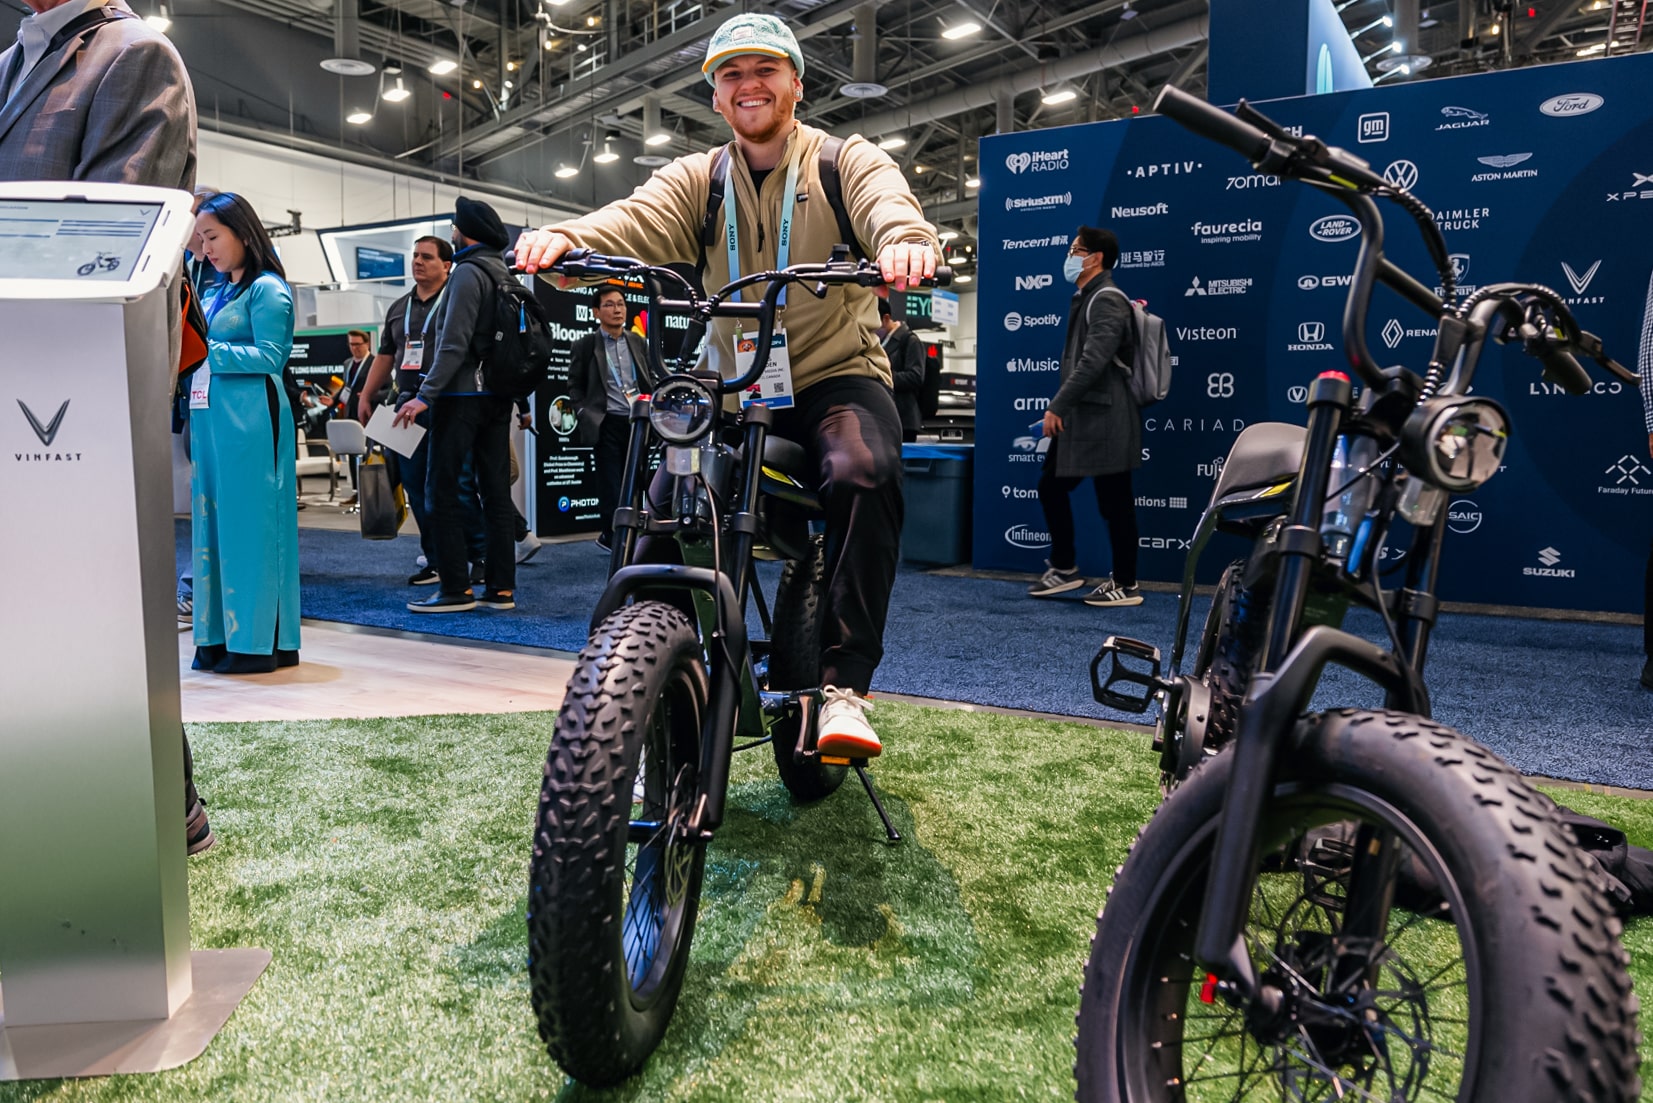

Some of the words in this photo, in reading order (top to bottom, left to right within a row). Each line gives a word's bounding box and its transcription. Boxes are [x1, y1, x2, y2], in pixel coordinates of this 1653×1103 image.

[1553, 97, 1590, 112] Ford
[1363, 119, 1384, 136] gm
[1435, 119, 1490, 131] JAGUAR
[1032, 149, 1069, 162] iHeart
[1031, 159, 1069, 172] RADIO
[1471, 173, 1501, 182] ASTON
[1503, 170, 1538, 180] MARTIN
[1606, 190, 1653, 202] XPE
[1111, 203, 1169, 218] Neusoft
[1193, 219, 1262, 236] faurecia
[1436, 219, 1480, 231] TRUCK
[1002, 237, 1050, 250] Tencent
[1201, 235, 1231, 244] inspiring
[1233, 233, 1262, 243] mobility
[1015, 274, 1053, 290] NXP
[1208, 278, 1252, 288] MITSUBISHI
[1208, 286, 1246, 295] ELECTRIC
[1433, 285, 1476, 297] Ferari
[1561, 296, 1605, 305] INFAST
[665, 315, 690, 329] natu
[1023, 314, 1061, 328] Spotify
[549, 322, 597, 341] Bloom
[1176, 327, 1237, 341] Visteon
[1406, 328, 1440, 337] RENA
[1288, 343, 1334, 351] HONDA
[1018, 358, 1060, 372] Music
[191, 390, 207, 399] TCL
[1530, 382, 1566, 395] LYN
[1014, 397, 1050, 410] arm
[1145, 418, 1245, 431] CARIAD
[15, 453, 82, 462] VINFAST
[1008, 453, 1036, 462] smart
[1013, 487, 1038, 499] tom
[1598, 486, 1629, 496] Faraday
[1448, 511, 1478, 520] SAIC
[1138, 537, 1191, 549] carx
[1523, 567, 1575, 577] SUZUKI
